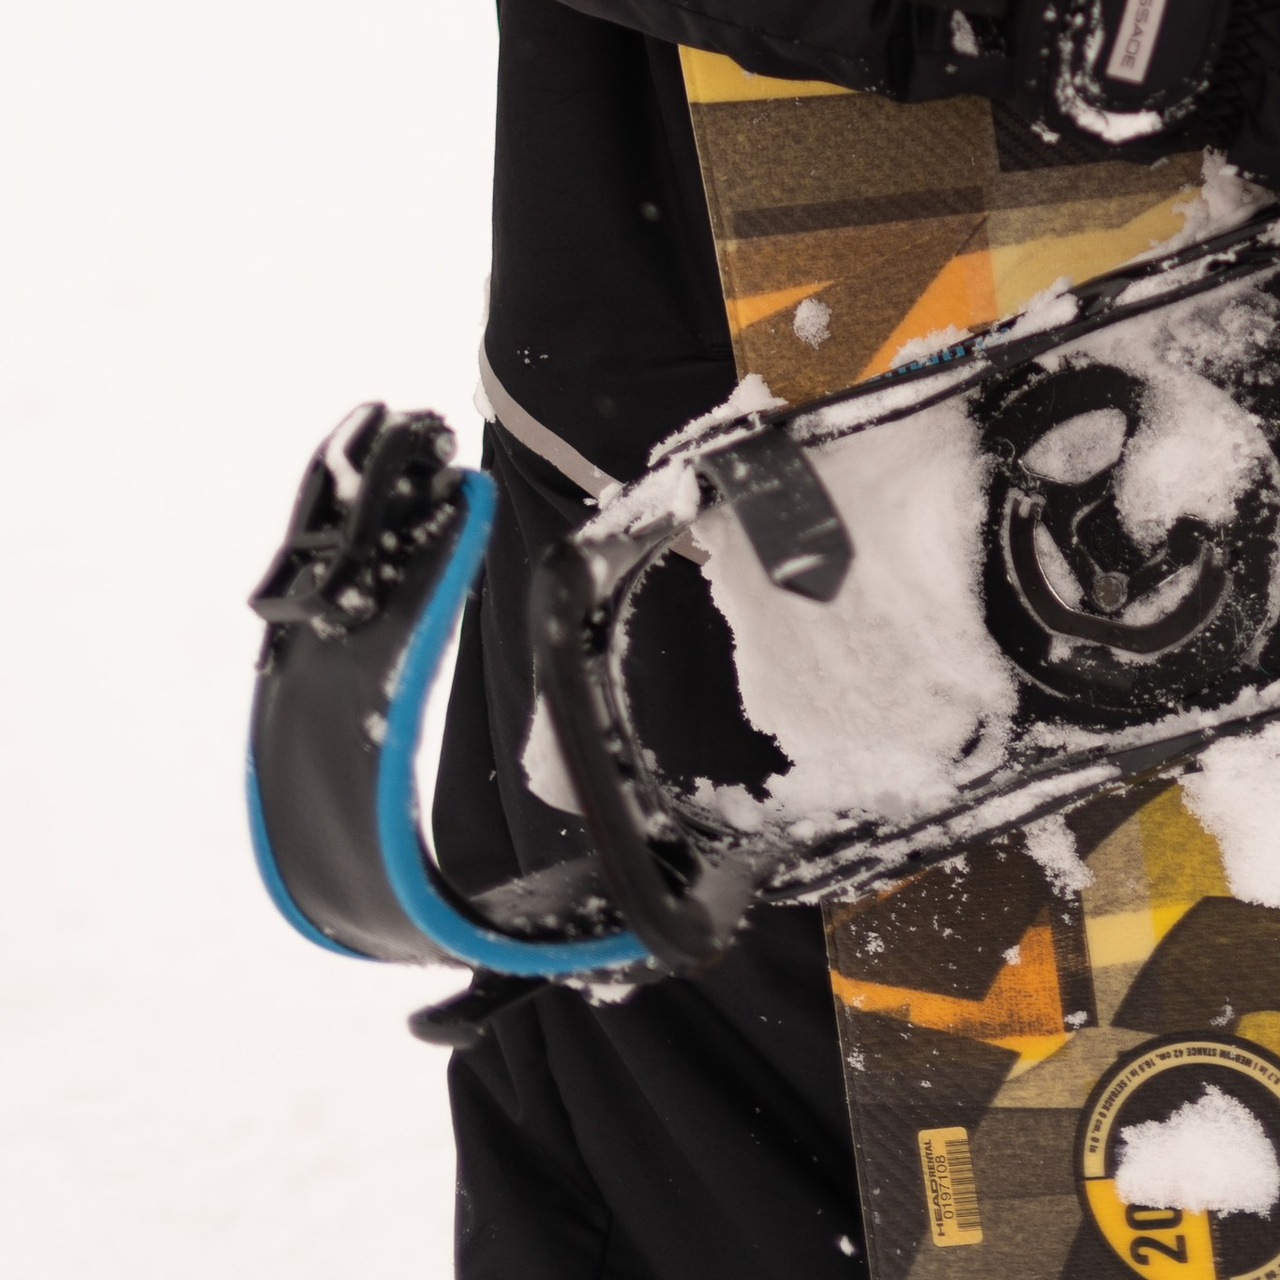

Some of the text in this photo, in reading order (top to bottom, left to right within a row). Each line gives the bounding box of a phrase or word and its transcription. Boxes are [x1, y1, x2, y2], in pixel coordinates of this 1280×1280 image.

[1173, 1048, 1184, 1058] 42
[1186, 1047, 1218, 1057] STANCE
[1101, 1079, 1128, 1112] SETBACK
[924, 1139, 945, 1236] HEAD RENTAL
[935, 1155, 954, 1219] 0197108
